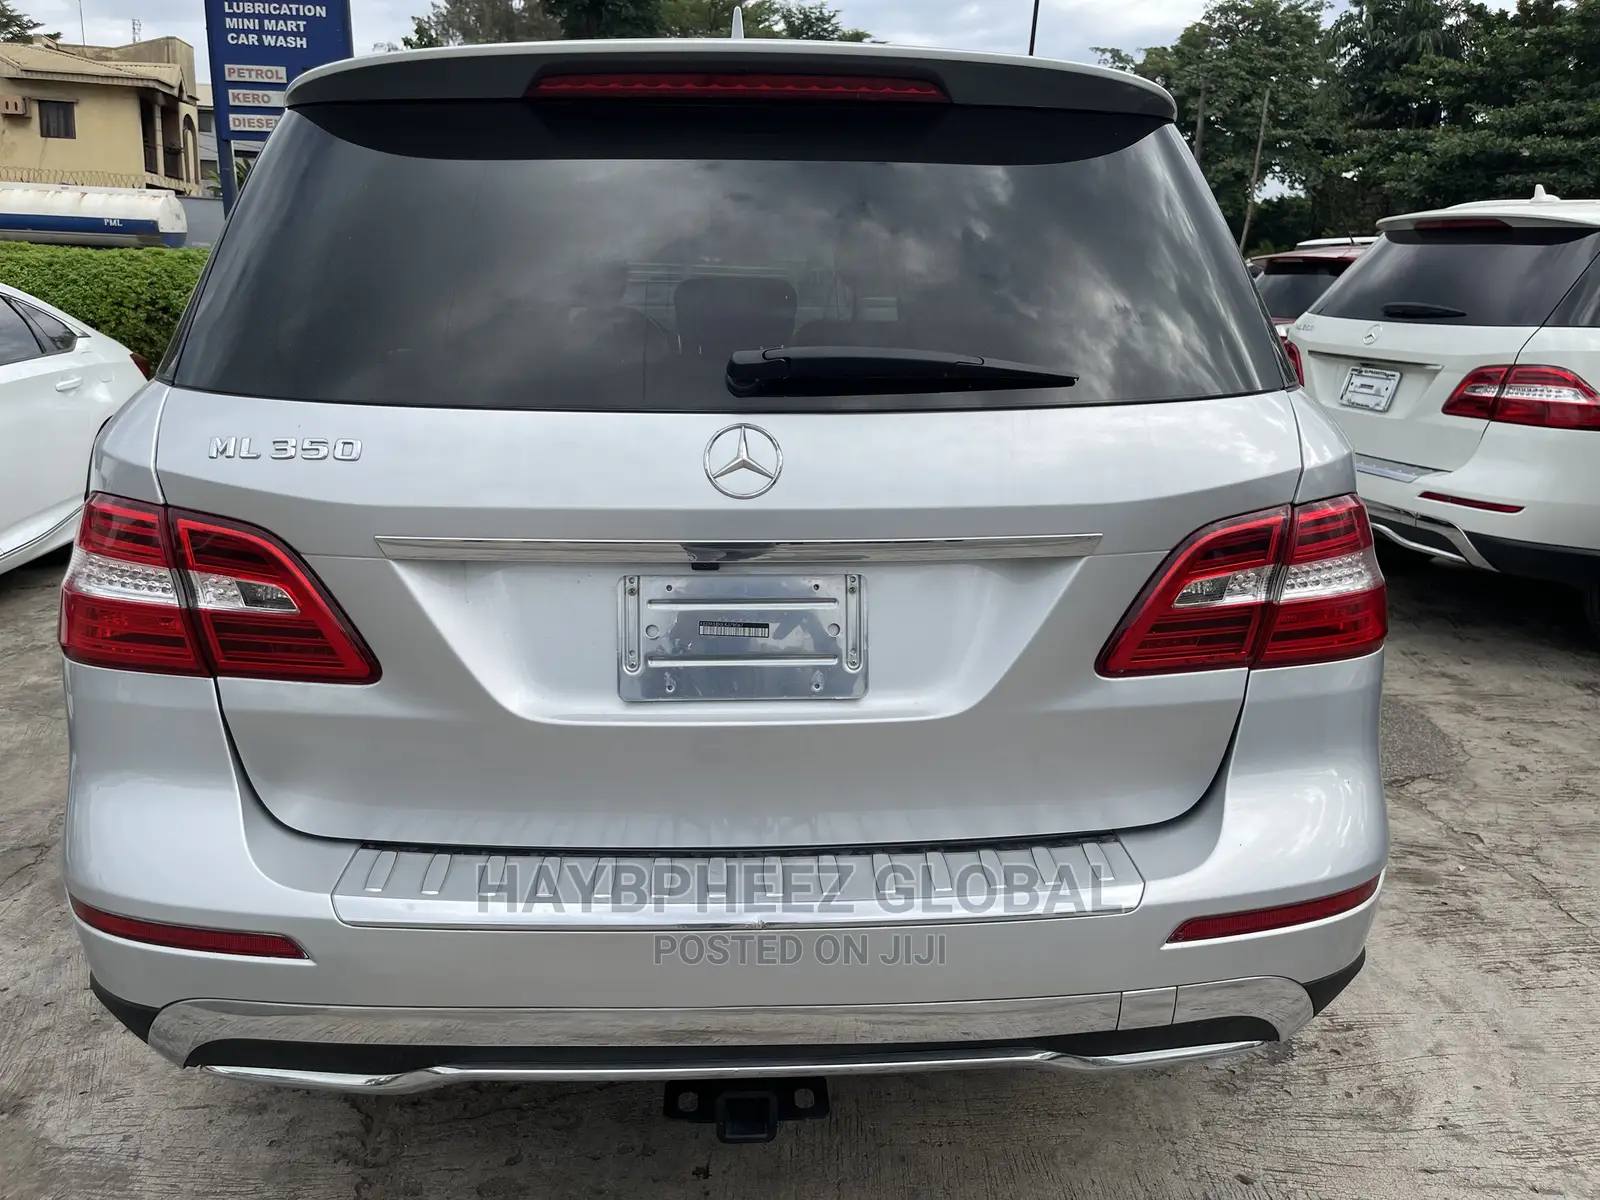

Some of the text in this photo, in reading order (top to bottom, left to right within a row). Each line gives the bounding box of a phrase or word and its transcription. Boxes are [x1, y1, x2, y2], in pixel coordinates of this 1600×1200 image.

[224, 1, 327, 17] LUBRICATION
[225, 17, 307, 32] MINI MART
[227, 33, 307, 48] CAR WASH
[227, 67, 284, 80] PETROL
[231, 92, 271, 104] KERO
[208, 436, 362, 461] ML 350
